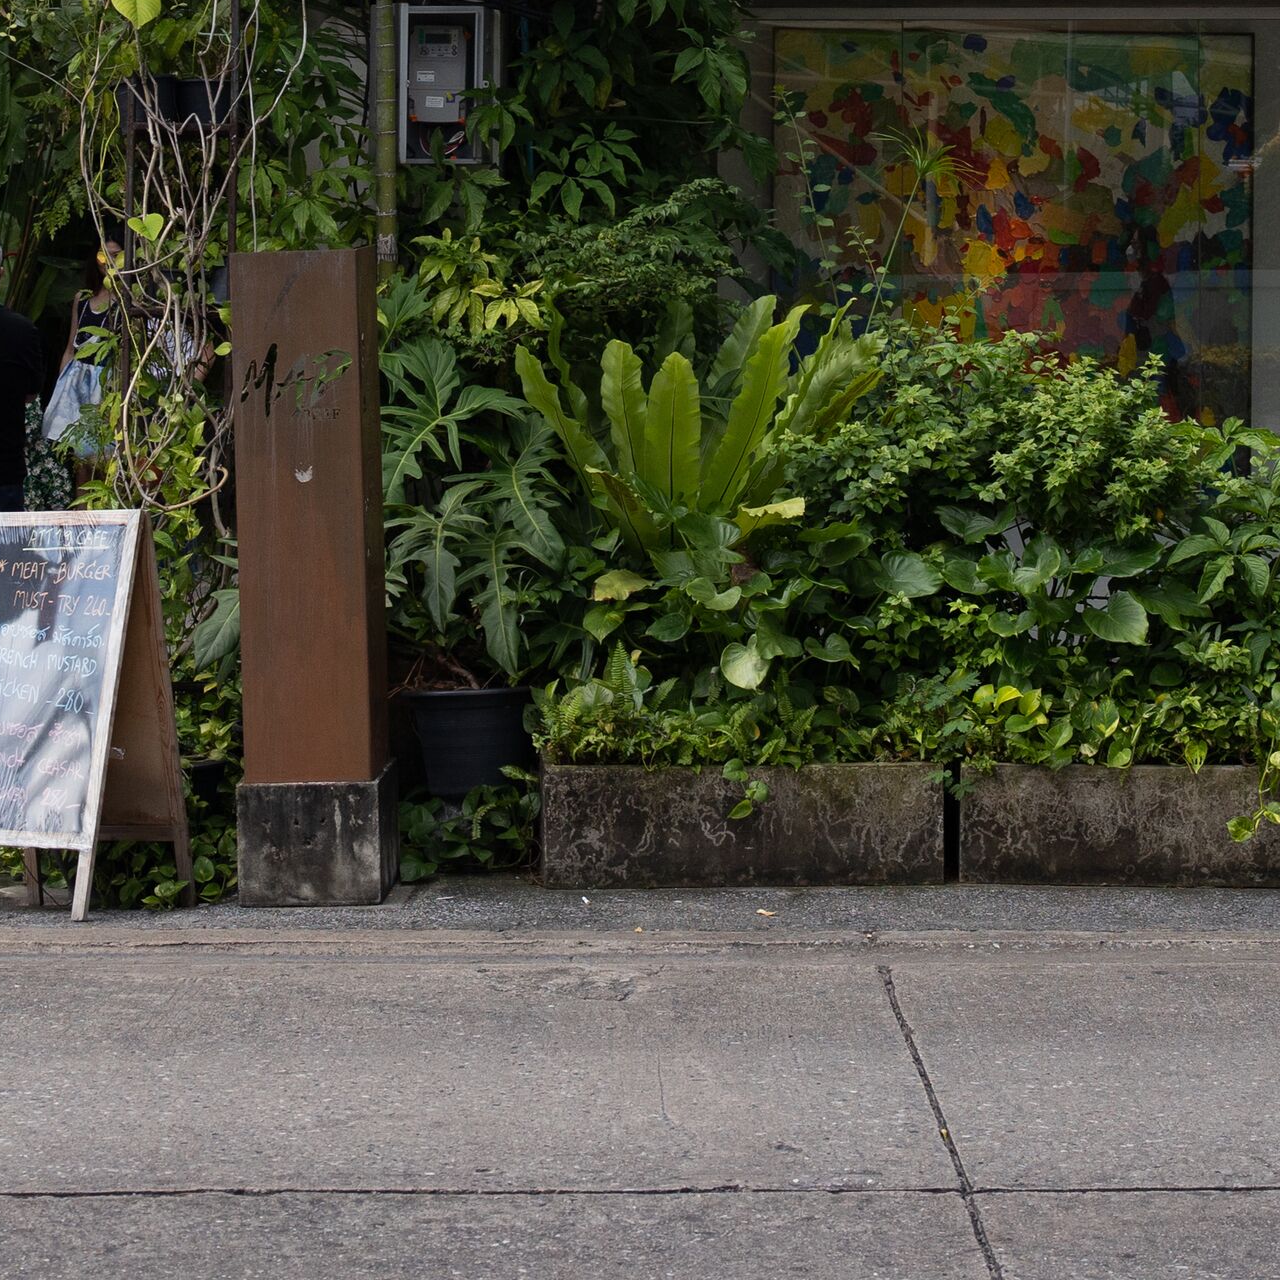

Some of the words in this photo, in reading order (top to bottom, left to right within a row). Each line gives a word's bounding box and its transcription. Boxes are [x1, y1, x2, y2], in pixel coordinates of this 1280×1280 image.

[11, 561, 49, 582] MEAT
[53, 559, 112, 584] BURGER
[47, 654, 97, 677] MUSTARD
